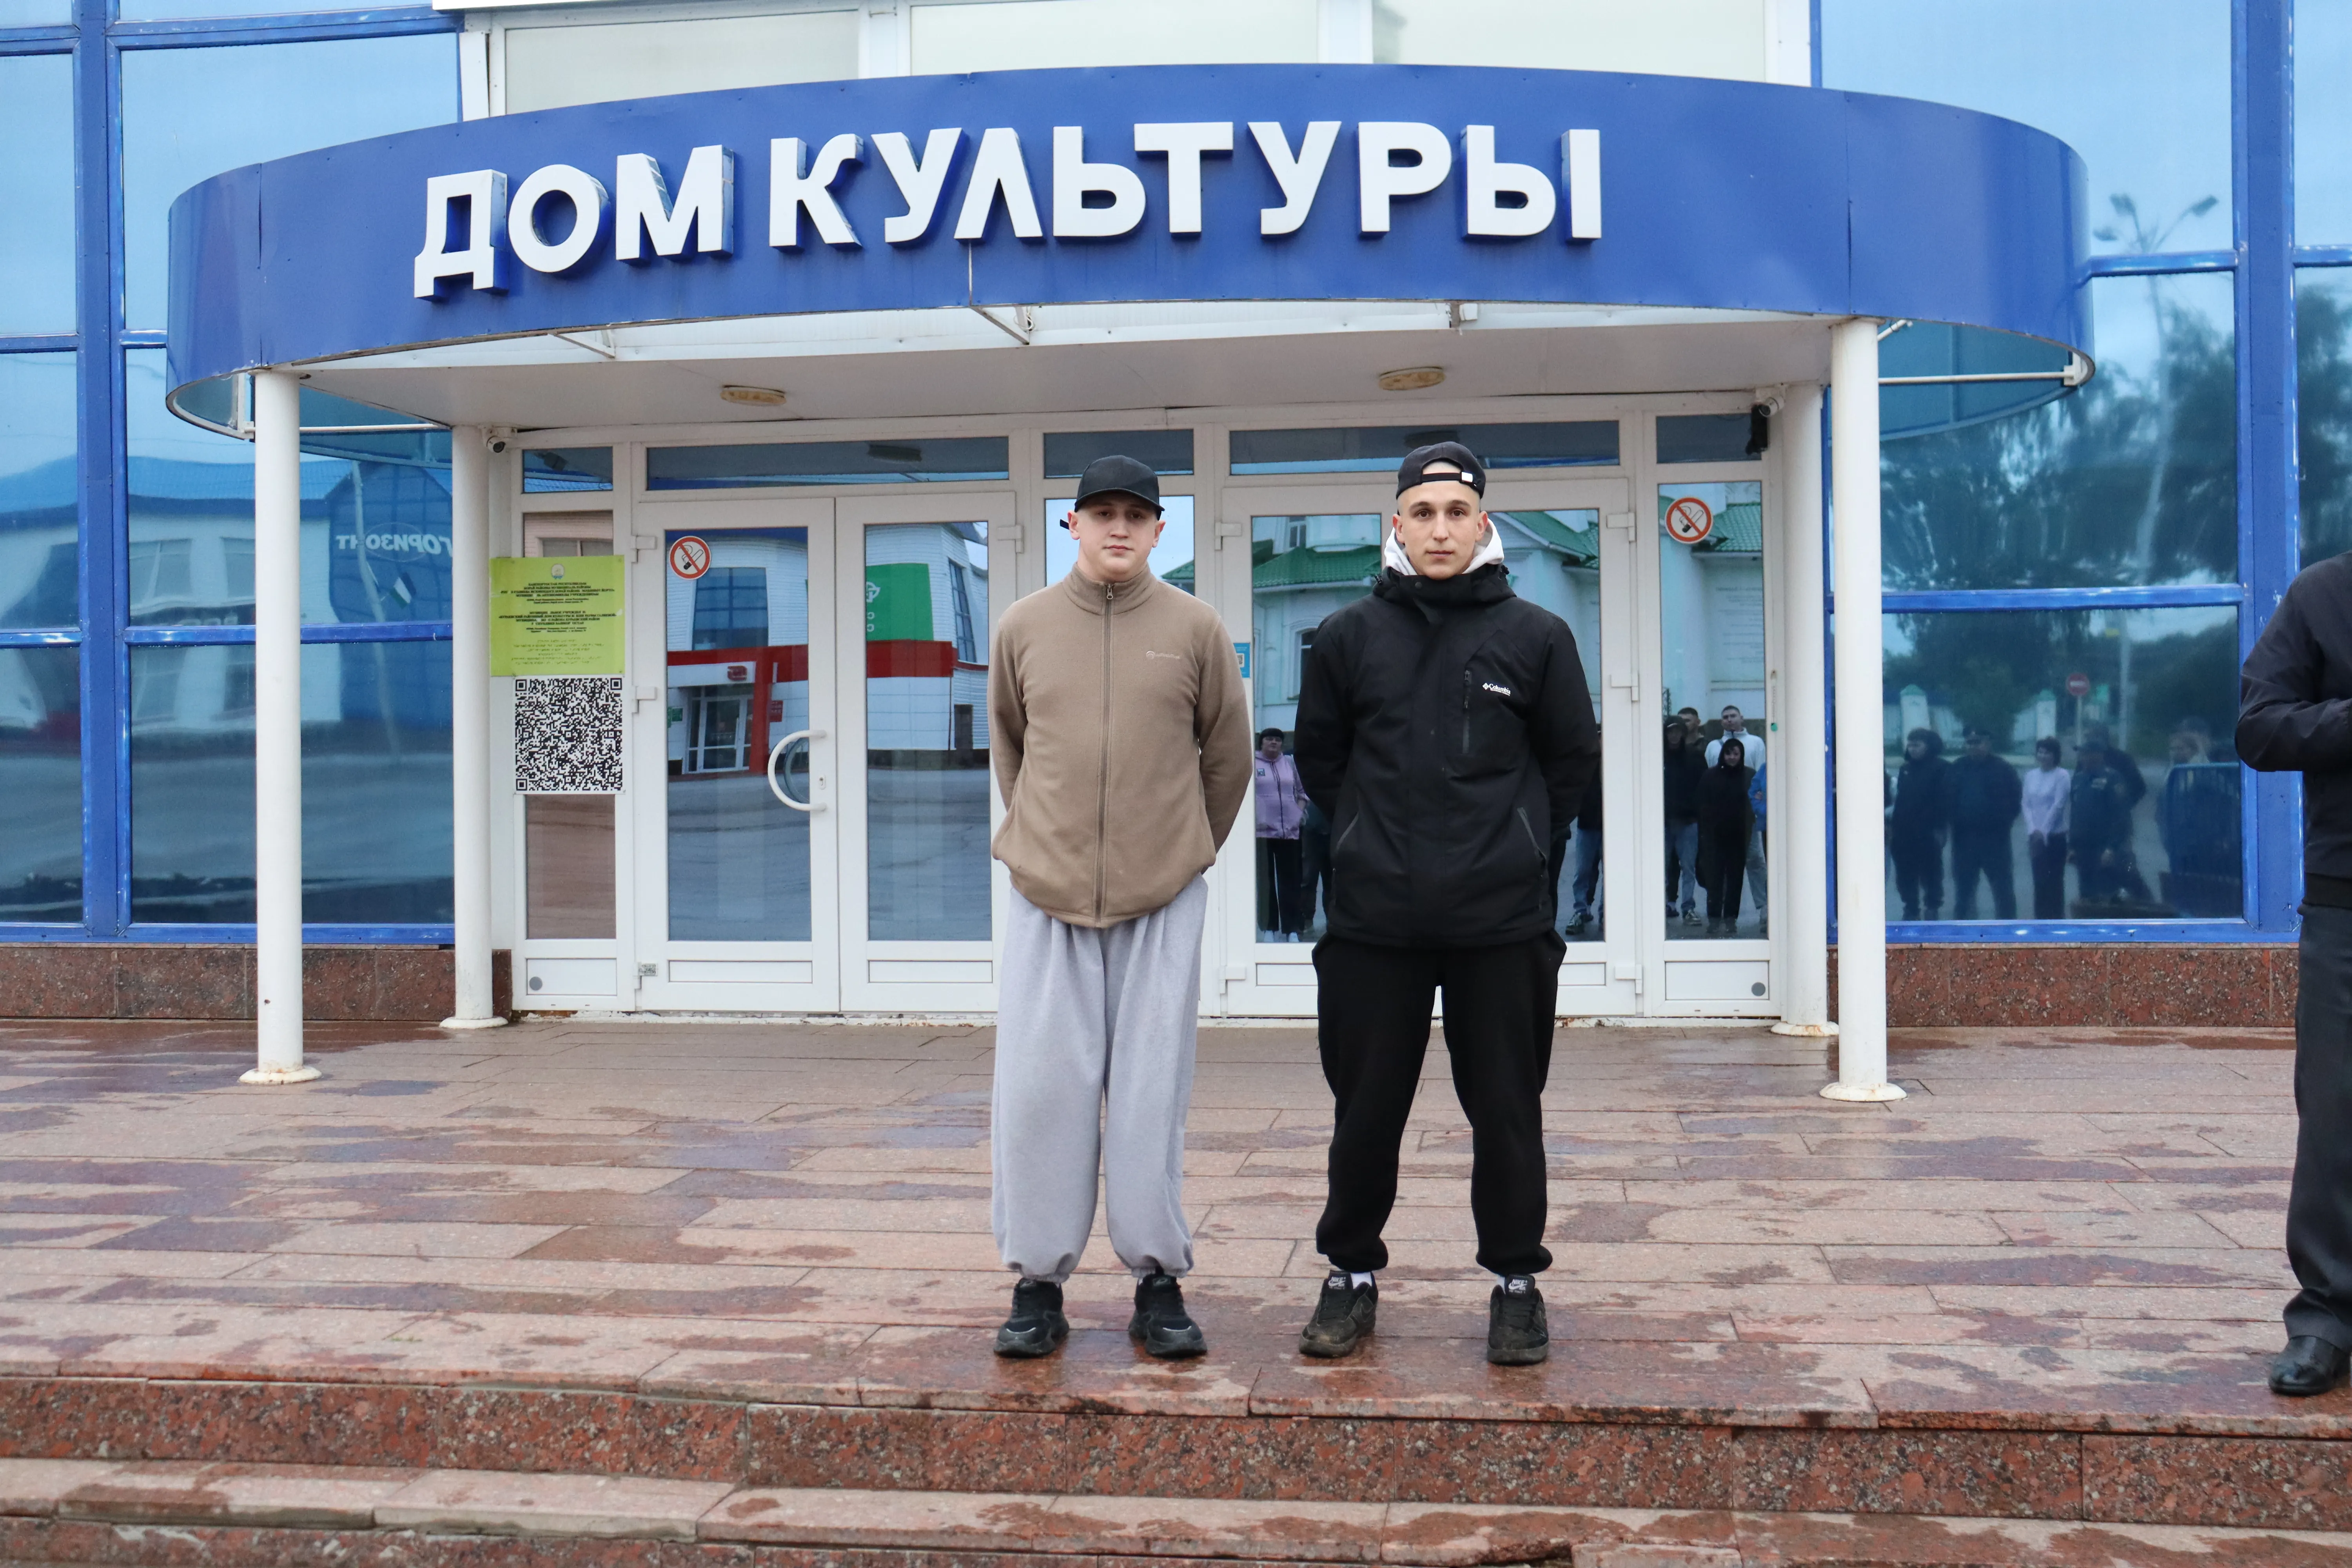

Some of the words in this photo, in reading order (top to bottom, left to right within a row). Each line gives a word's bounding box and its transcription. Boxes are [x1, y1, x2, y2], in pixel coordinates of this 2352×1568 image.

[414, 144, 734, 300] ДОМ
[769, 121, 1601, 248] КУЛЬТУРЫ
[1489, 683, 1511, 694] Columbia
